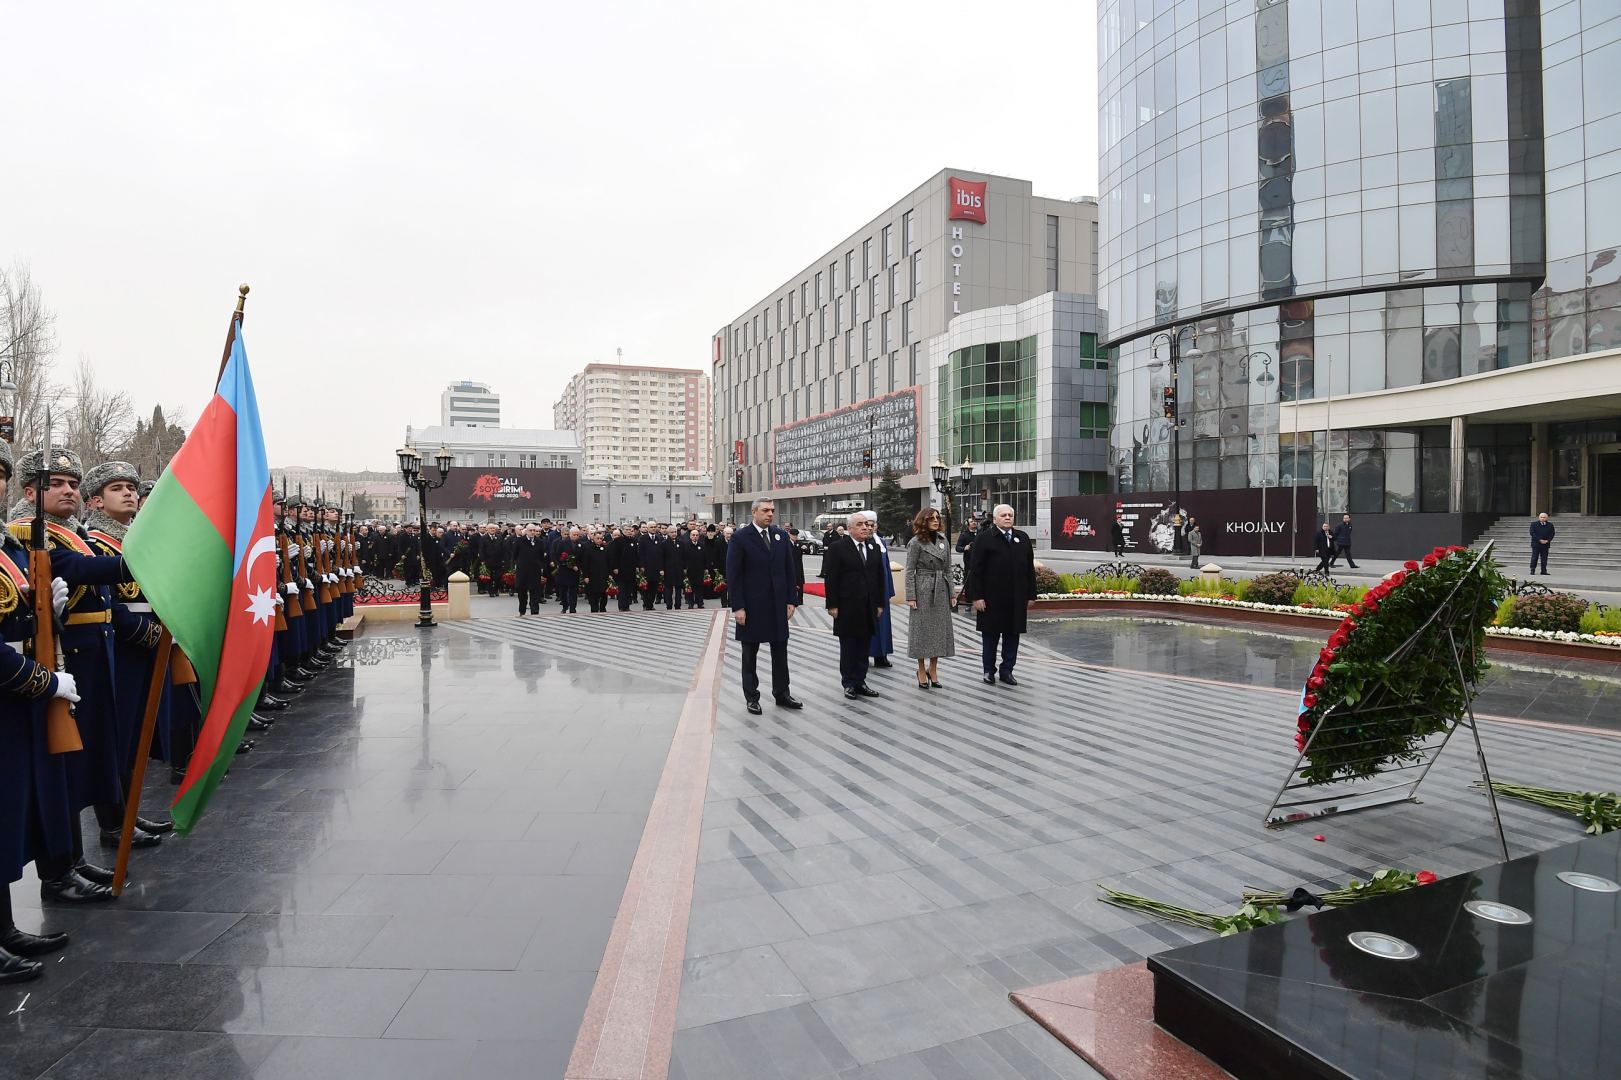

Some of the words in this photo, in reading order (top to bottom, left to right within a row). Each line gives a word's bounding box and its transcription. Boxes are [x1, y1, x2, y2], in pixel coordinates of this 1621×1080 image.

[956, 189, 982, 208] ibis
[951, 226, 964, 314] HOTEL
[1226, 521, 1286, 533] KHOJALY
